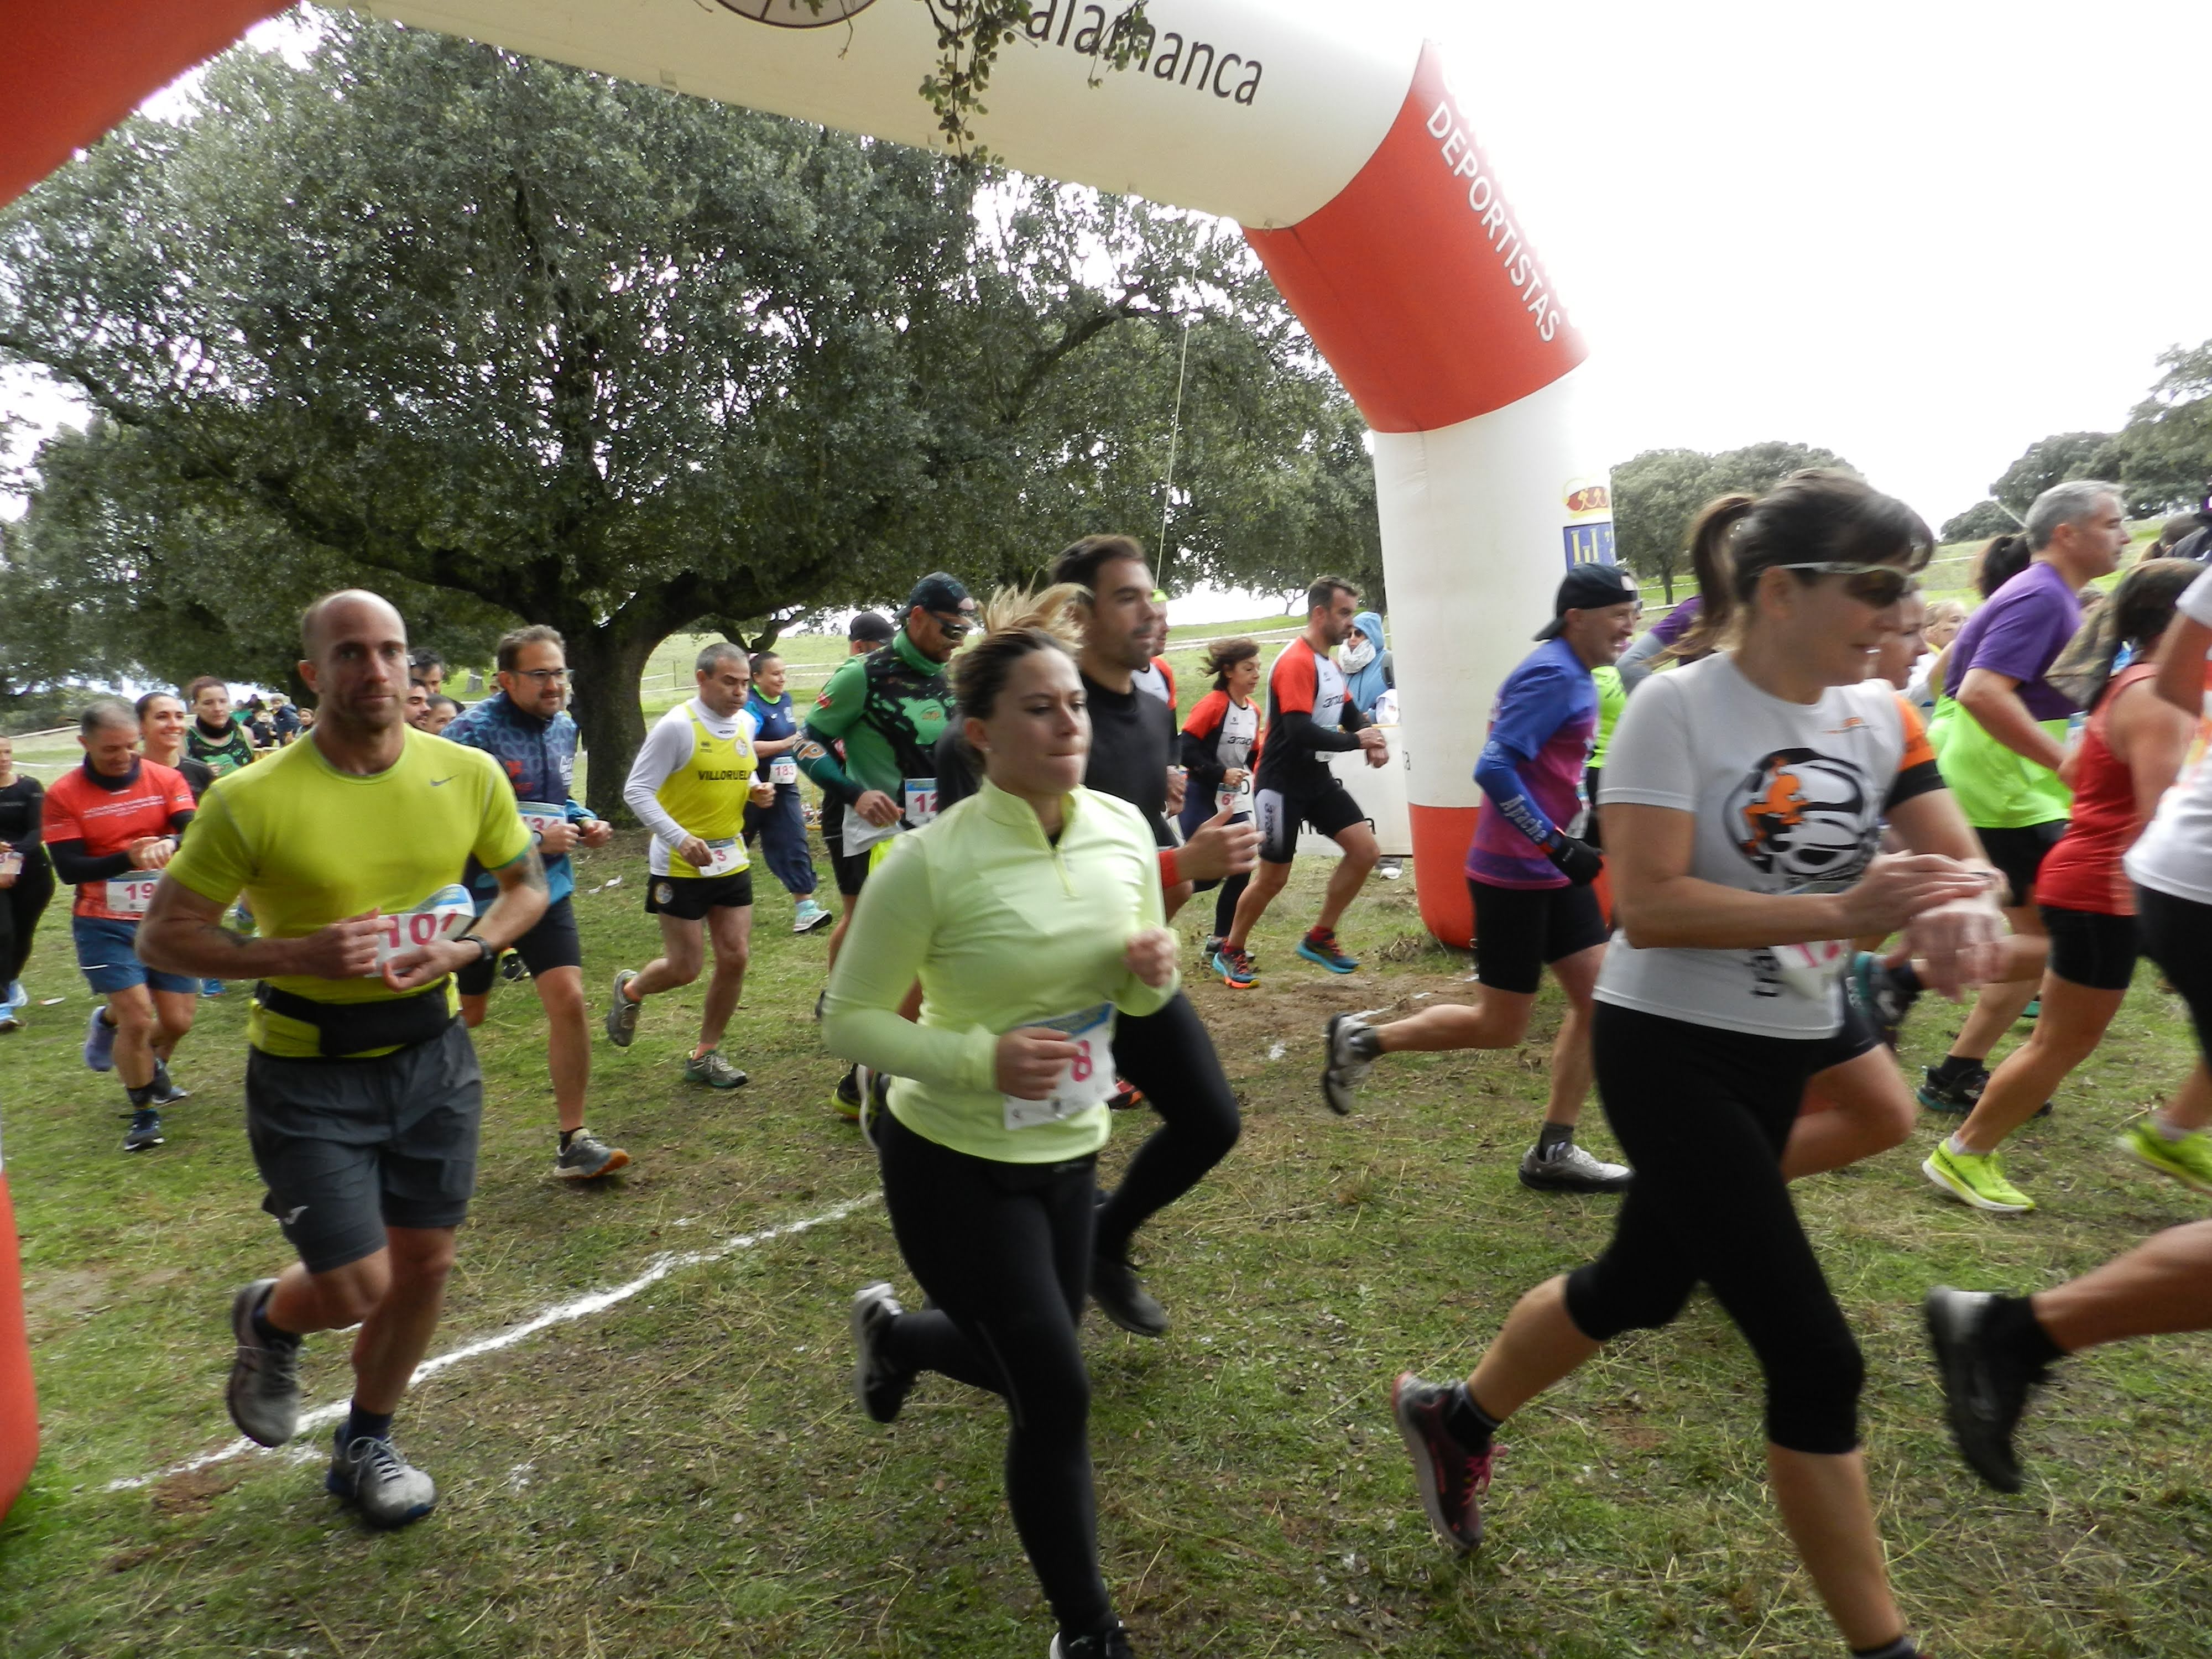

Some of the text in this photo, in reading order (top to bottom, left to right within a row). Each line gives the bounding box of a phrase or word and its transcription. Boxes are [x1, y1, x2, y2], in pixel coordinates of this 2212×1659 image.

[1426, 101, 1560, 342] DEPORTISTAS
[1227, 736, 1252, 745] 3730
[775, 765, 794, 776] 183
[1499, 794, 1548, 842] Apache
[124, 883, 154, 900] 19
